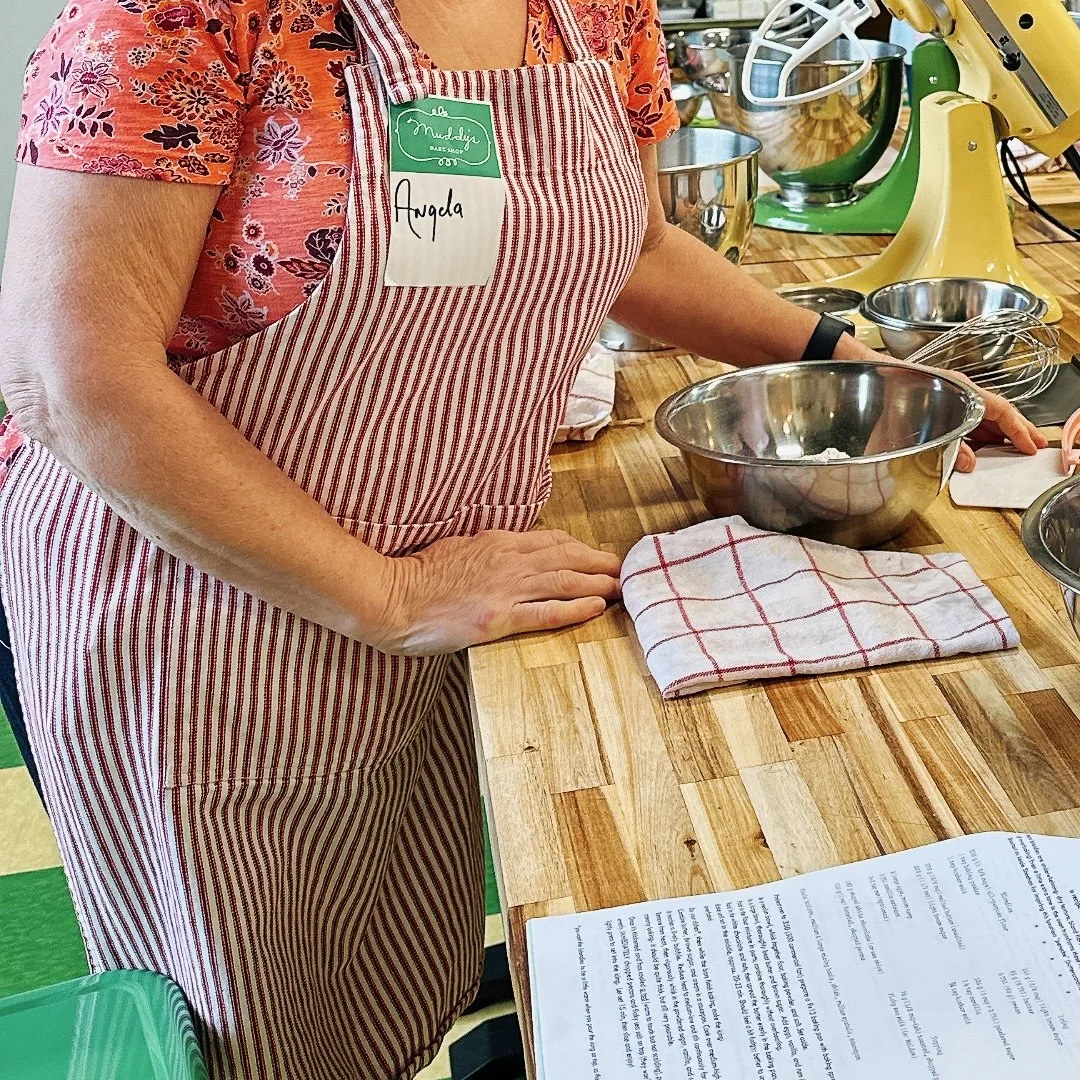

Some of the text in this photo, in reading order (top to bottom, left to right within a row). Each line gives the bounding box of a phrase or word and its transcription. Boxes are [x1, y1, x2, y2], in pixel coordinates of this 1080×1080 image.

[406, 117, 480, 151] Muddy's
[394, 178, 464, 242] Angela
[1071, 893, 1080, 909] recipe
[782, 920, 791, 930] 350
